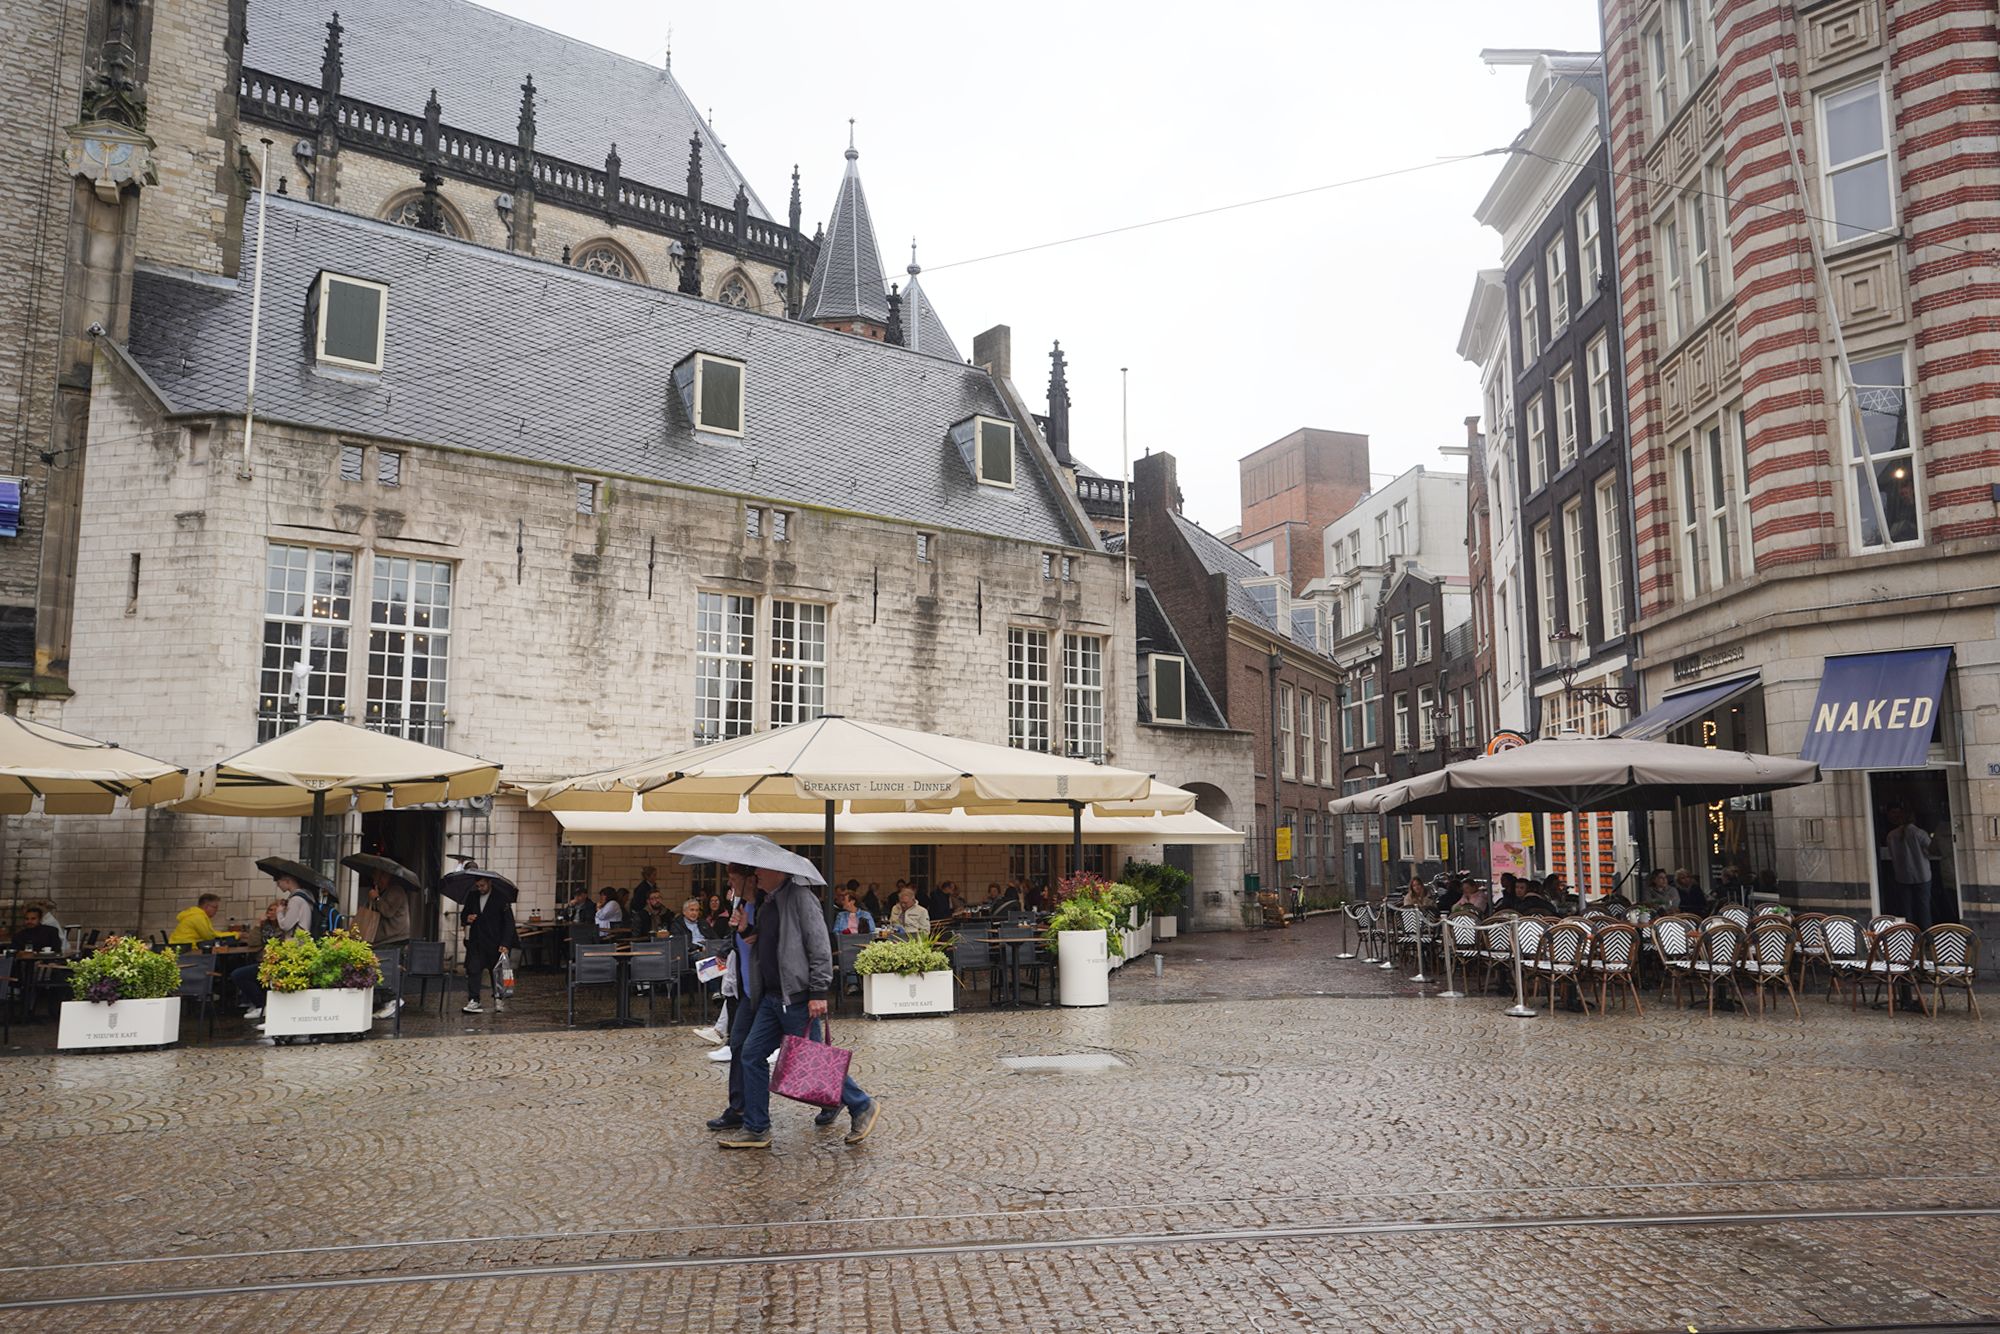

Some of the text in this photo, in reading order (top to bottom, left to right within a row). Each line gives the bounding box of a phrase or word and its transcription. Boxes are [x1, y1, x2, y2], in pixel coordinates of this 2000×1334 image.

[1814, 697, 1933, 733] NAKED
[803, 780, 861, 792] BREAKFAST
[870, 780, 904, 792] LUNCH
[913, 780, 952, 792] DINNER
